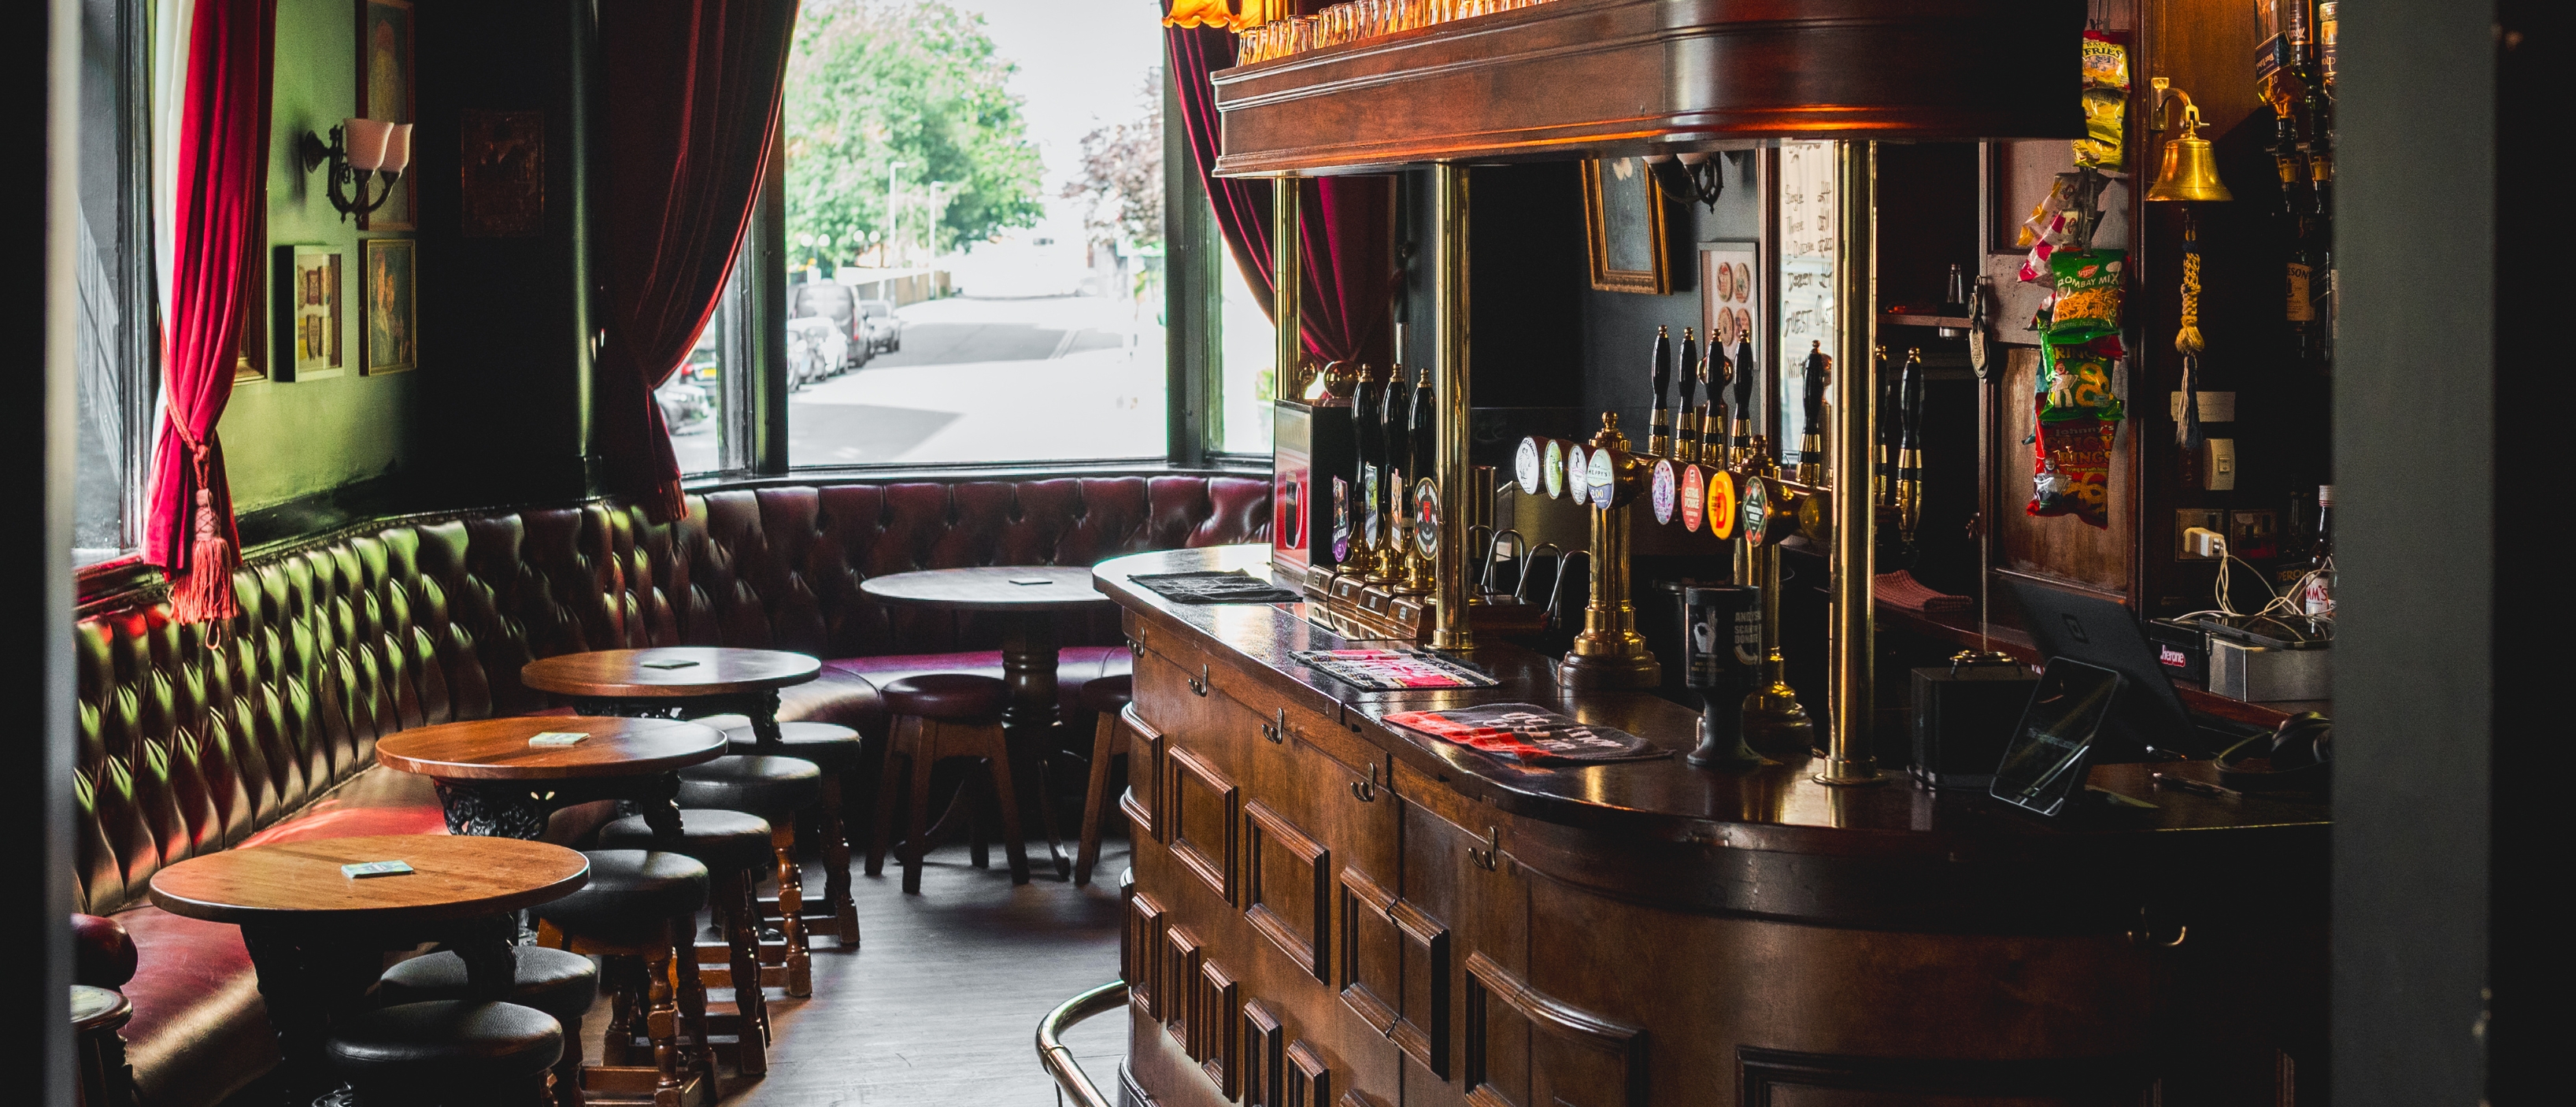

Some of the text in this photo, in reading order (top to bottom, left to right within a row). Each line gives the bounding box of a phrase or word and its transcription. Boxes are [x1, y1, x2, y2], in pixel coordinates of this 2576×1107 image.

[2083, 46, 2123, 58] FRIES
[2058, 273, 2119, 288] BOMBAY MIX
[2288, 268, 2309, 280] ESON
[2044, 435, 2115, 451] SPICY
[2307, 584, 2328, 602] MM'S
